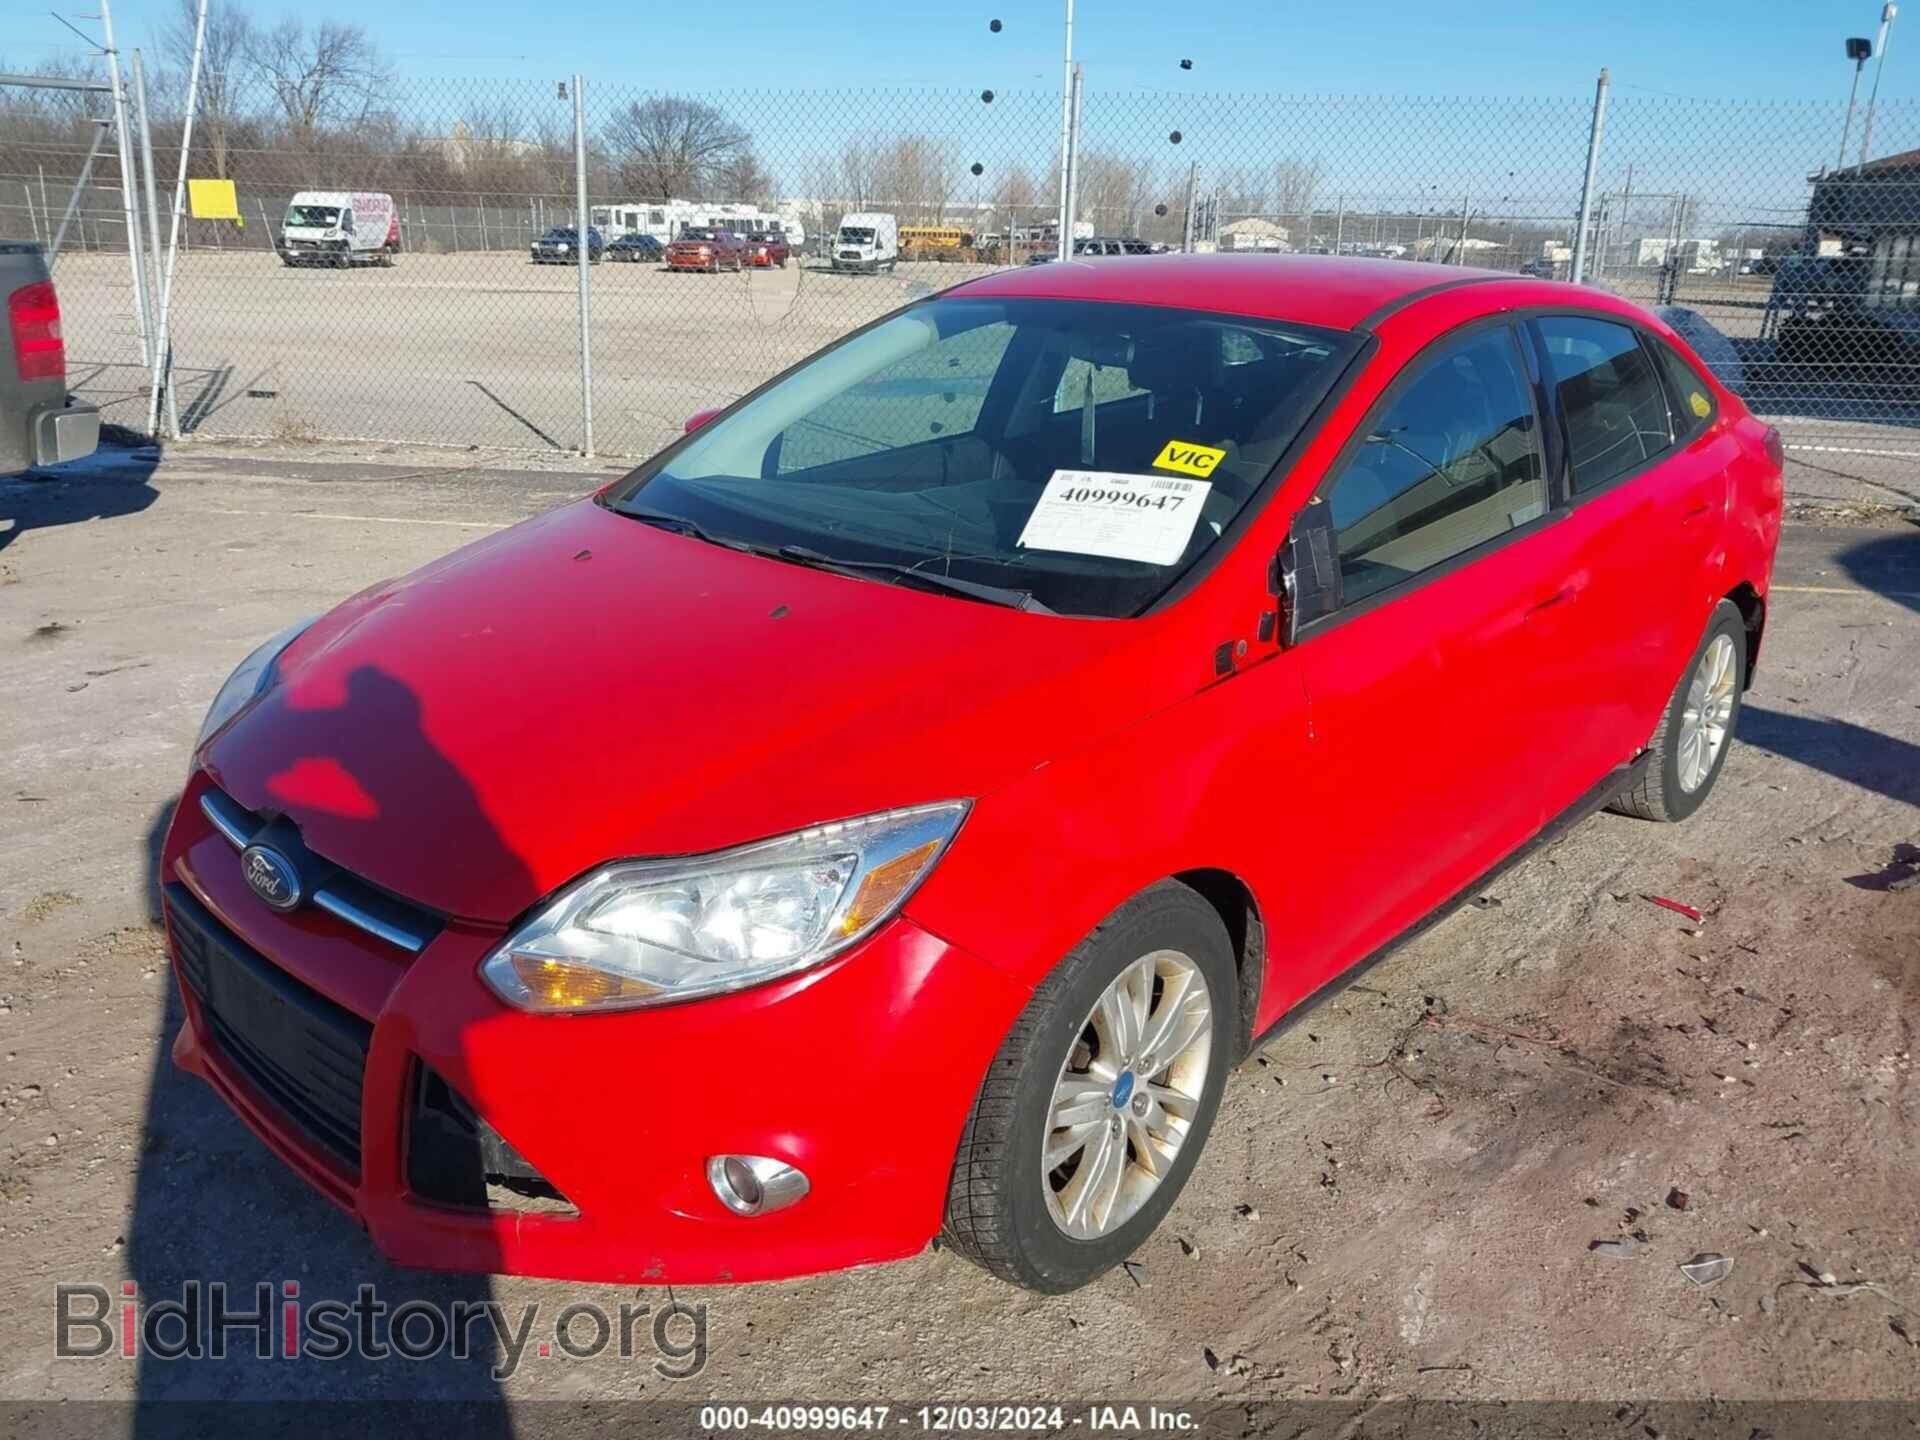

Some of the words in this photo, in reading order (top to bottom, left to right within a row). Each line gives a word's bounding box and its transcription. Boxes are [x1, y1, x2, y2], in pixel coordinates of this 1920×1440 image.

[1168, 447, 1215, 469] VIC
[1059, 487, 1185, 512] 40999647
[247, 854, 281, 896] Ford
